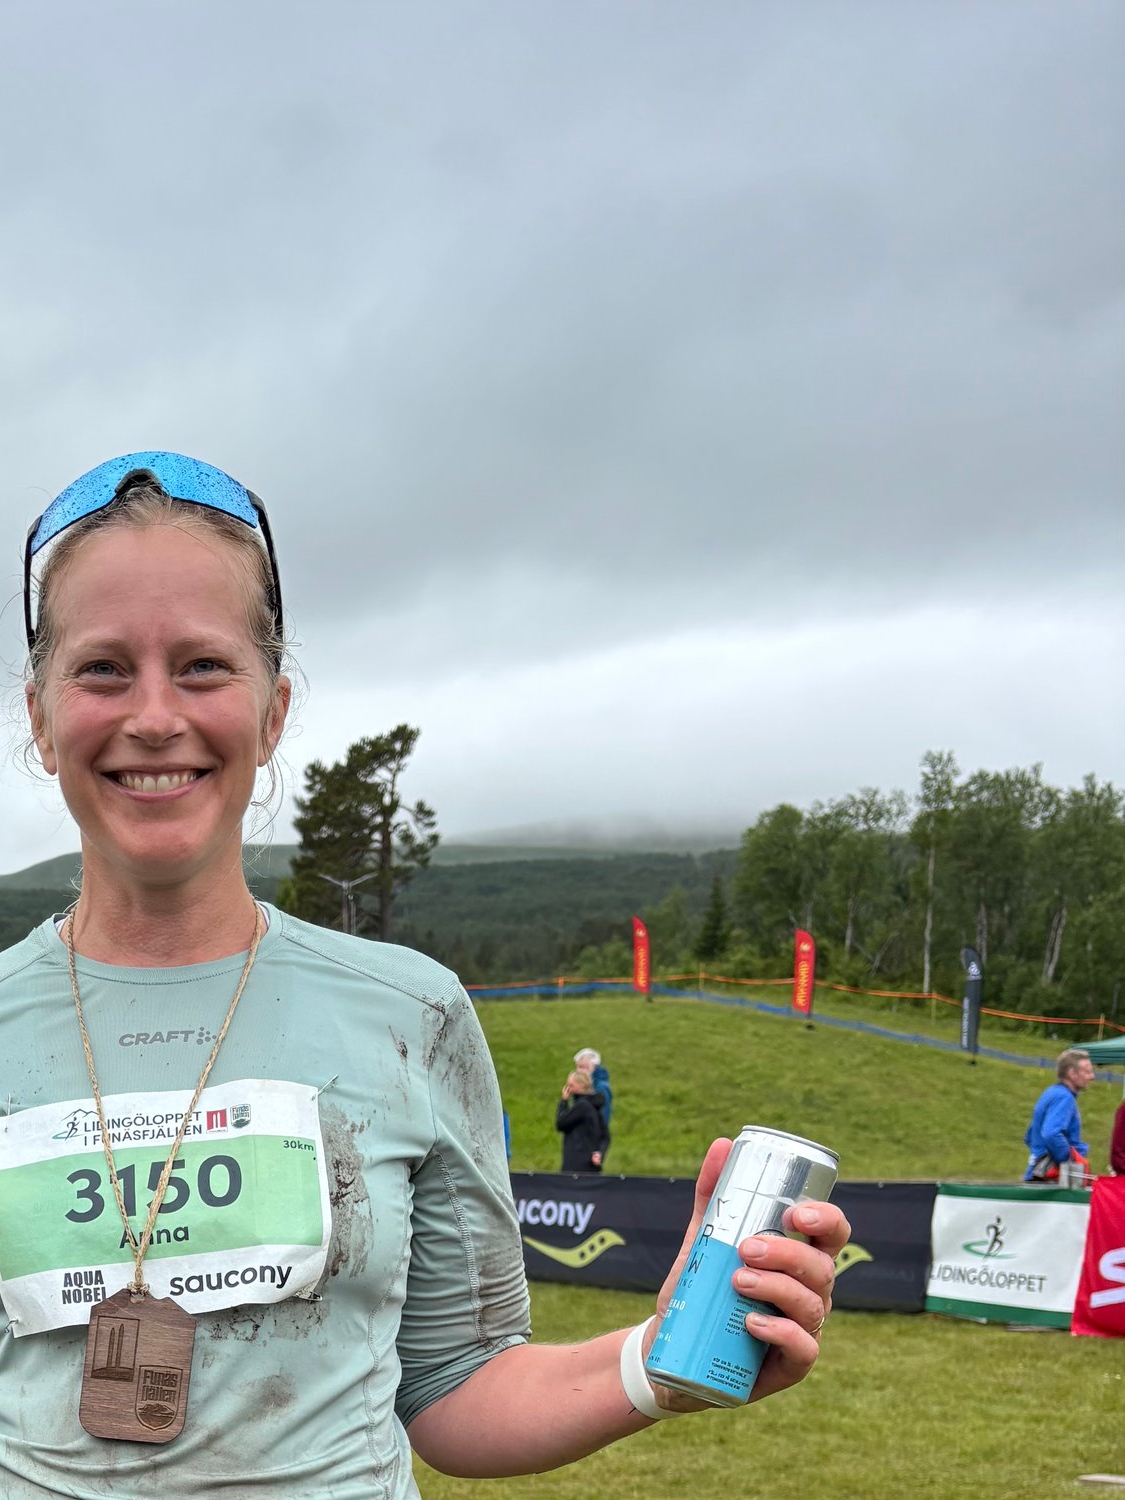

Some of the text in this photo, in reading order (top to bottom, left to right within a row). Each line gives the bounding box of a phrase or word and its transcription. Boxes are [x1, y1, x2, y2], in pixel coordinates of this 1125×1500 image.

[118, 1030, 195, 1047] CRAFT
[84, 1136, 87, 1146] I
[283, 1140, 314, 1152] 30km
[65, 1154, 242, 1223] 3150
[119, 1226, 190, 1248] Anna
[63, 1270, 104, 1288] AQUA
[169, 1264, 293, 1297] saucony
